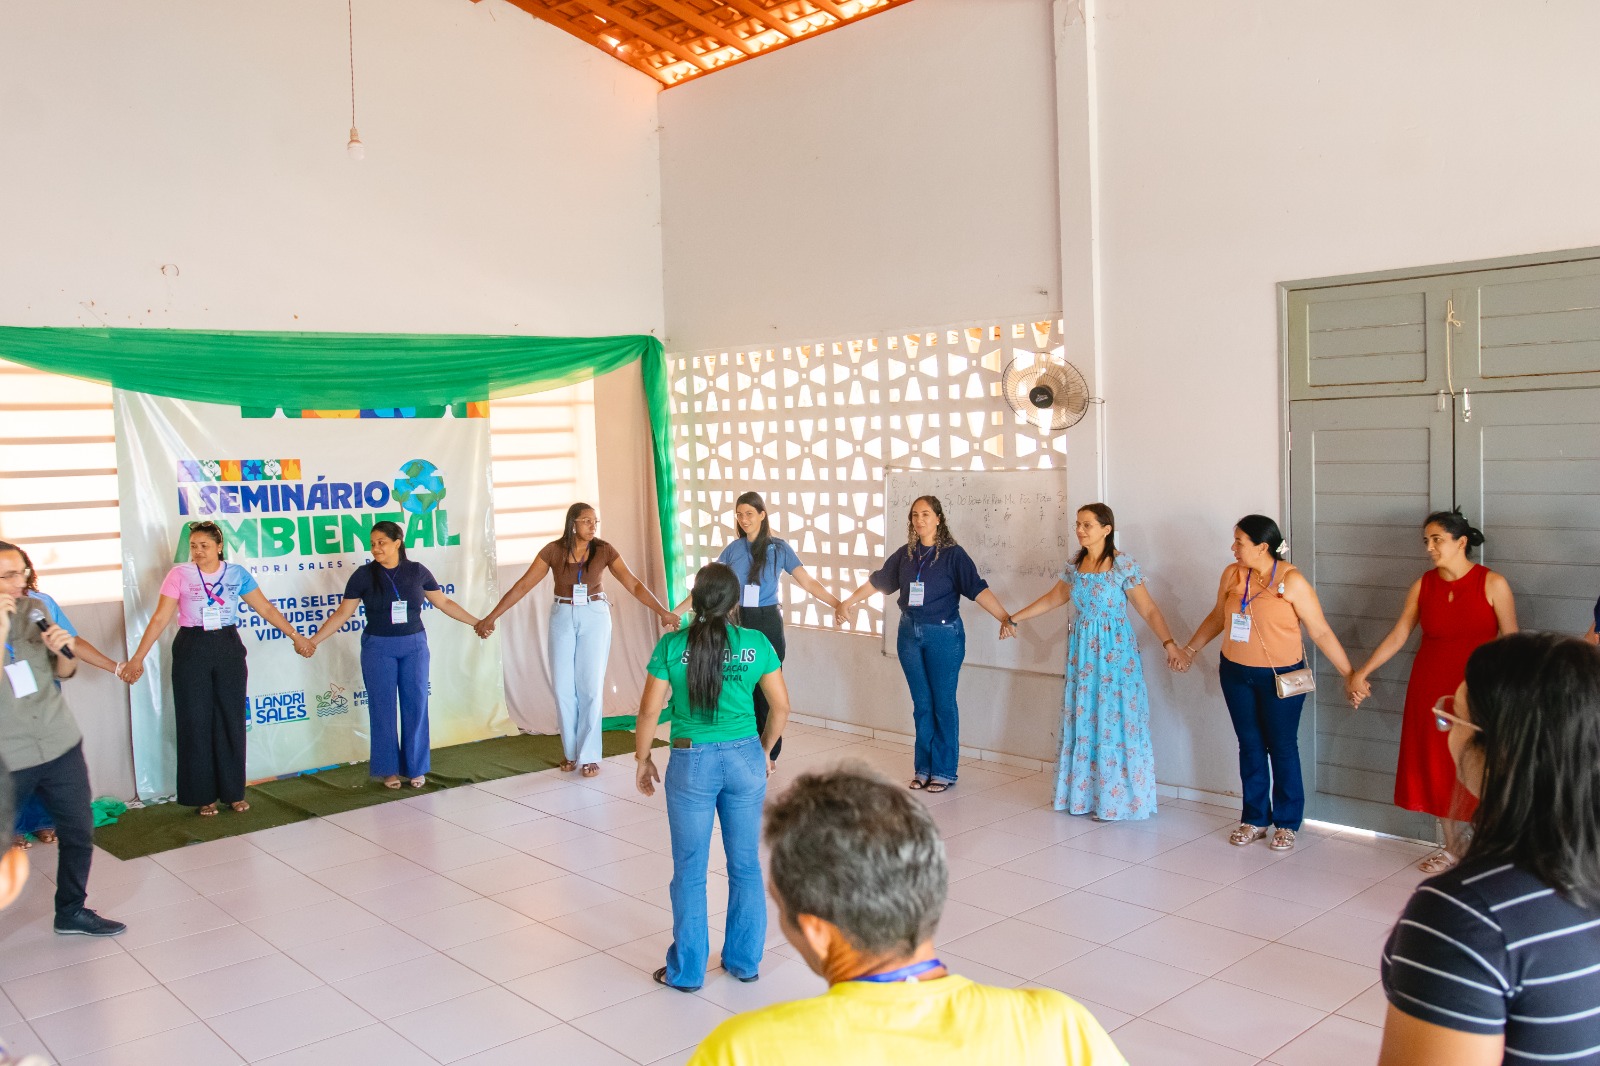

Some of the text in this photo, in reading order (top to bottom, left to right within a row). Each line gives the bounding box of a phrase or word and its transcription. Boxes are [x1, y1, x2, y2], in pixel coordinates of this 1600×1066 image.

[177, 476, 390, 515] I SEMINÁRIO
[250, 564, 288, 574] NDRI
[298, 560, 343, 572] SALES
[740, 648, 756, 663] LS
[255, 692, 304, 710] LANDRI
[256, 704, 307, 724] SALES
